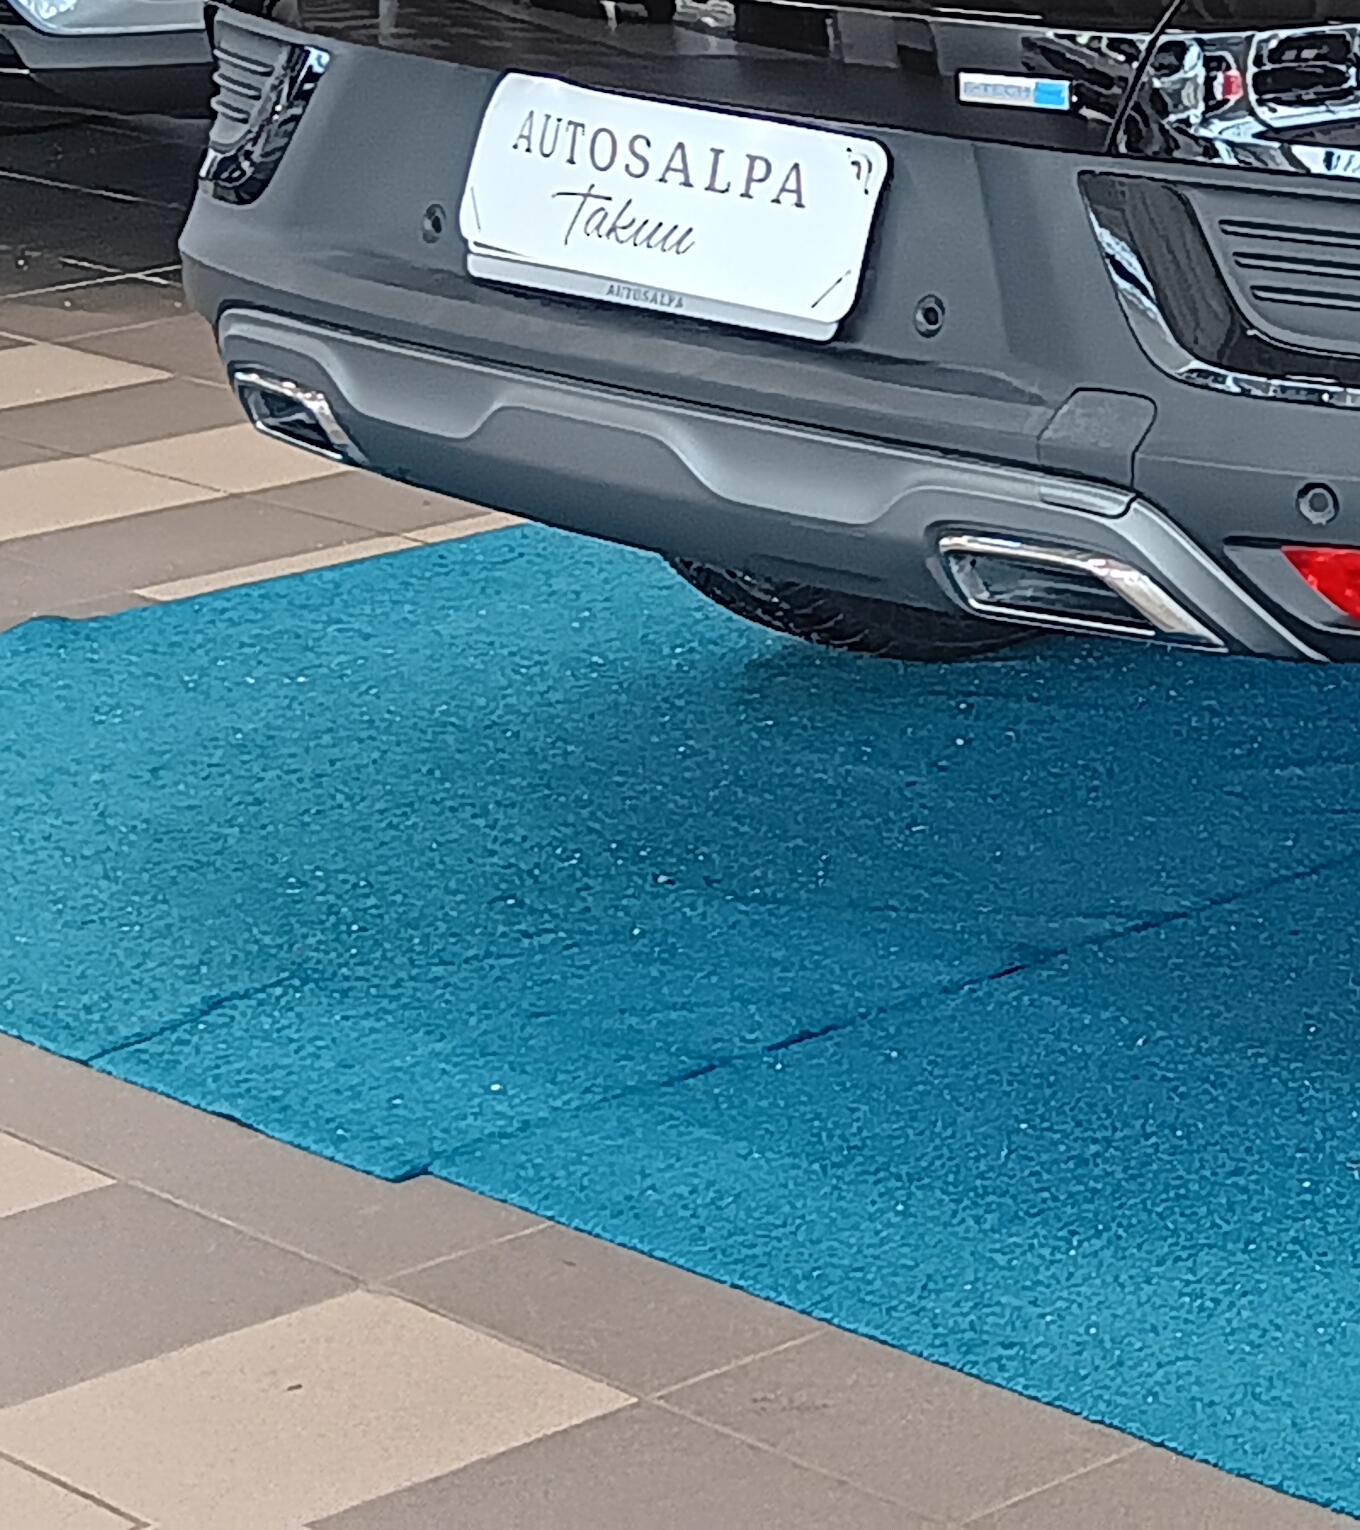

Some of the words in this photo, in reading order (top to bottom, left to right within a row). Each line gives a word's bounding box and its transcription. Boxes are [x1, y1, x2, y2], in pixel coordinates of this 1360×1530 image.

[512, 109, 806, 208] AUTOSALPA
[552, 183, 696, 255] Takuu
[606, 283, 684, 309] AUTOSALPA
